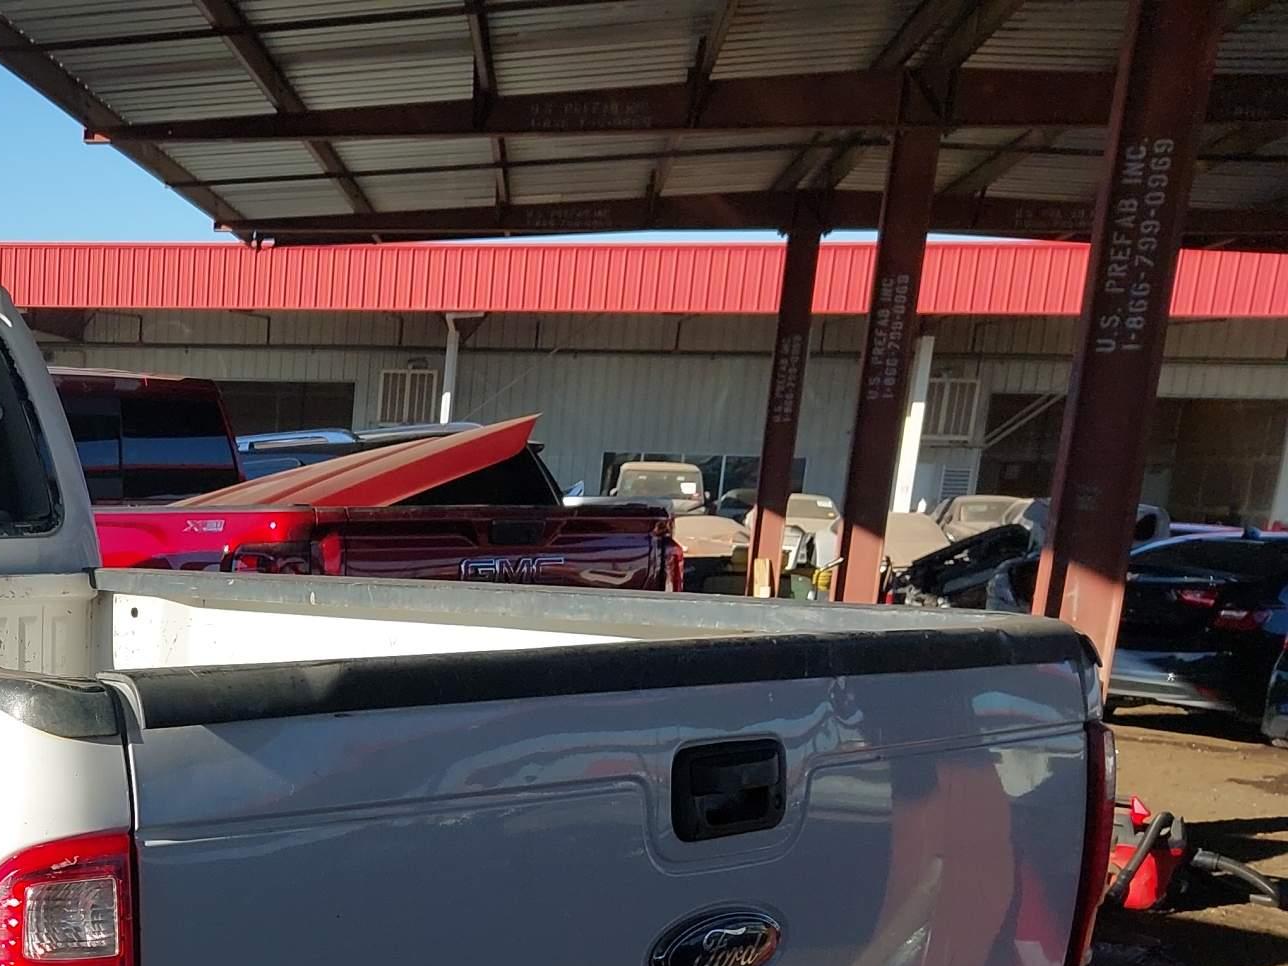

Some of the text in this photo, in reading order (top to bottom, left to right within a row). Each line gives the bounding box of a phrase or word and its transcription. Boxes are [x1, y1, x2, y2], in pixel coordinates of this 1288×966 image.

[1120, 136, 1150, 185] INC.
[1105, 198, 1139, 294] PREFAB
[1121, 137, 1175, 351] 1-866-799-0969
[460, 556, 565, 583] GMC
